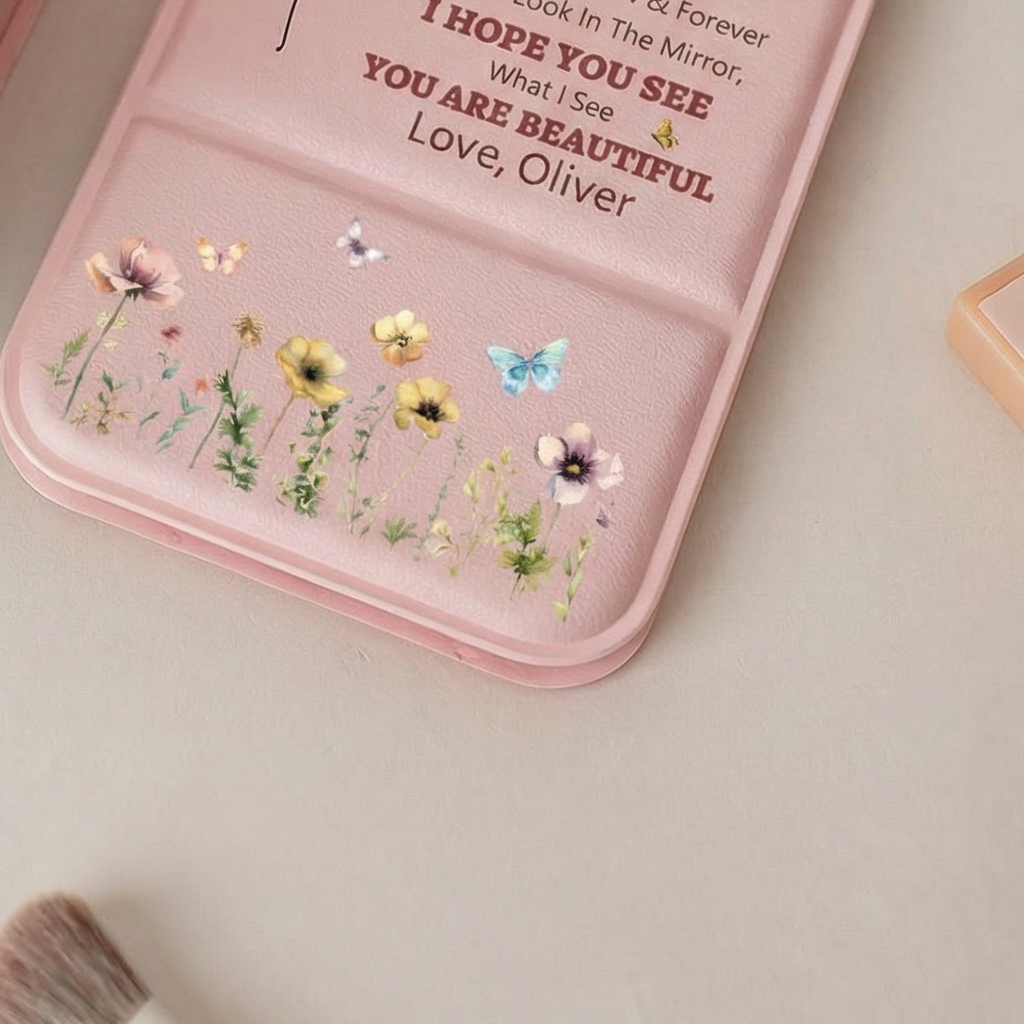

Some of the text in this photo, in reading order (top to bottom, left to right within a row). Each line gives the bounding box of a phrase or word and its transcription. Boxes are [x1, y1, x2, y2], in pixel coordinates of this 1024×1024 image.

[442, 3, 551, 63] HOPE
[556, 41, 639, 91] YOU
[638, 74, 715, 121] SEE
[578, 6, 602, 33] In
[611, 16, 654, 52] The
[659, 35, 744, 87] Mirror,
[675, 0, 771, 50] Forever
[362, 51, 715, 204] YOU ARE BEAUTIFUL
[490, 59, 615, 123] What I See
[406, 110, 637, 218] Love, Oliver
